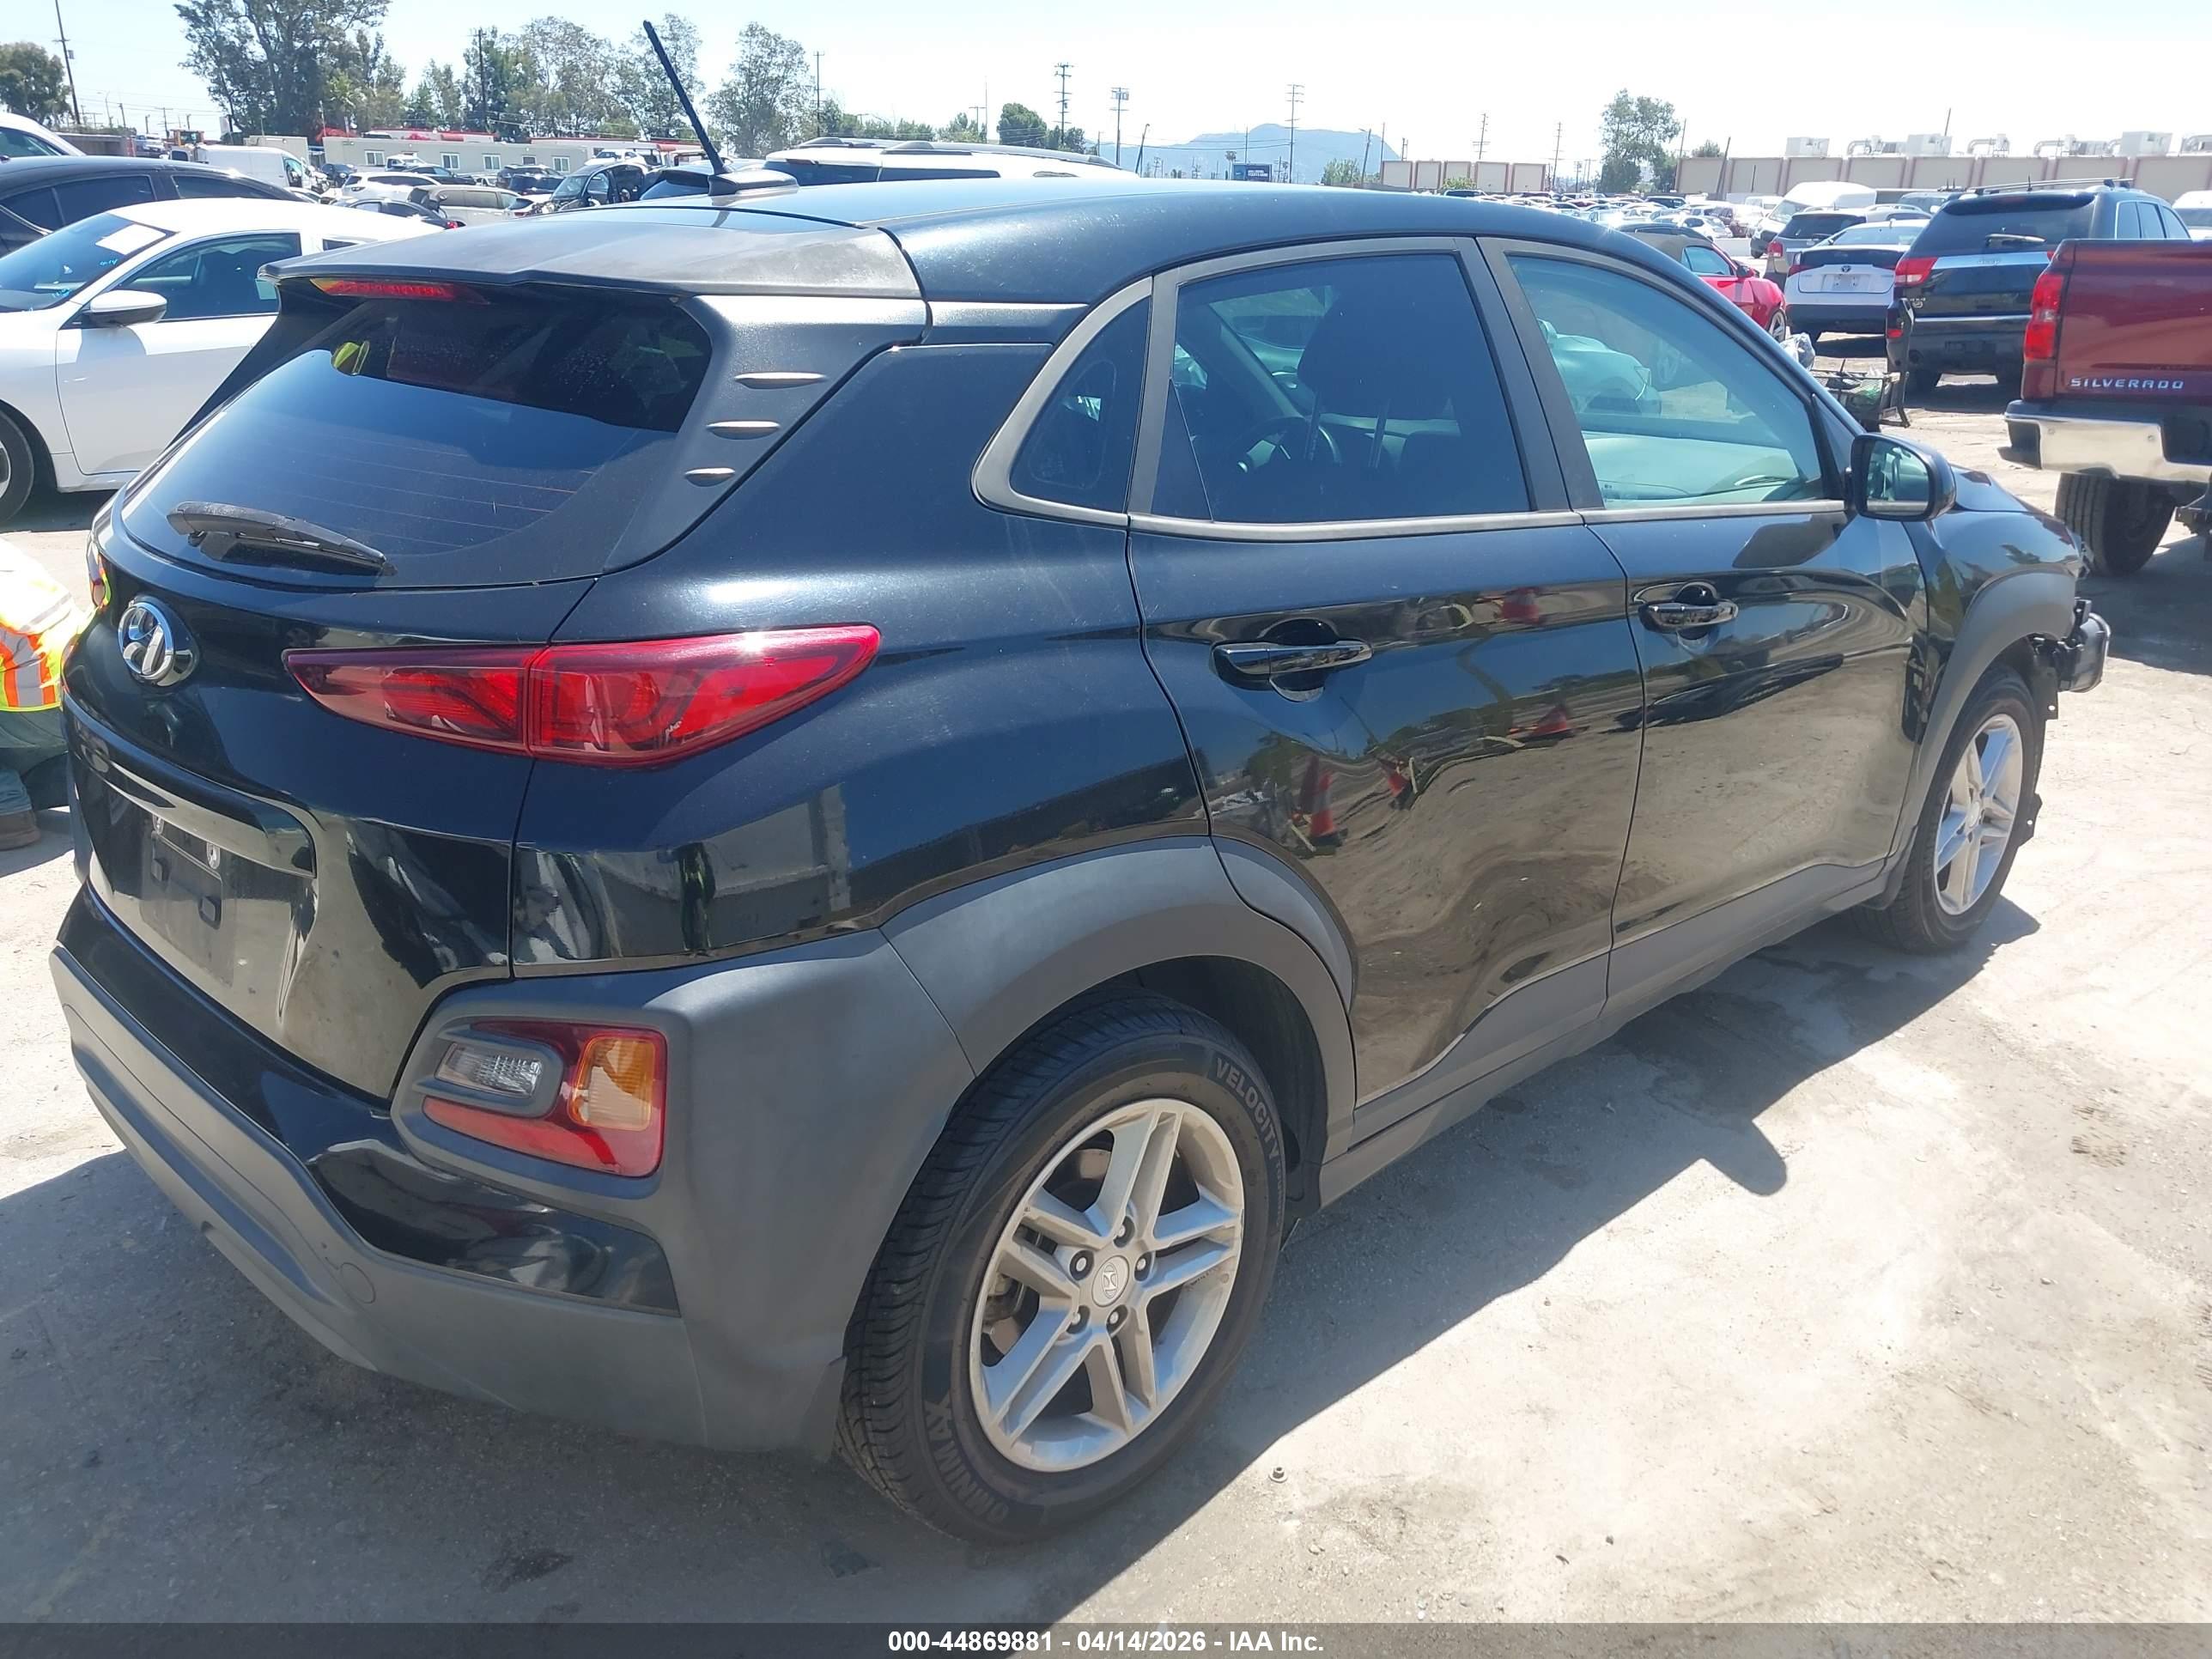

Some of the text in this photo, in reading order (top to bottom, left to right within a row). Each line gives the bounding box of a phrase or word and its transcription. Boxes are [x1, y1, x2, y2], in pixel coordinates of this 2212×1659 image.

[2070, 377, 2185, 390] SILVERADO
[1216, 1056, 1280, 1159] VELOCITY
[923, 1392, 1009, 1522] OMNIMAX
